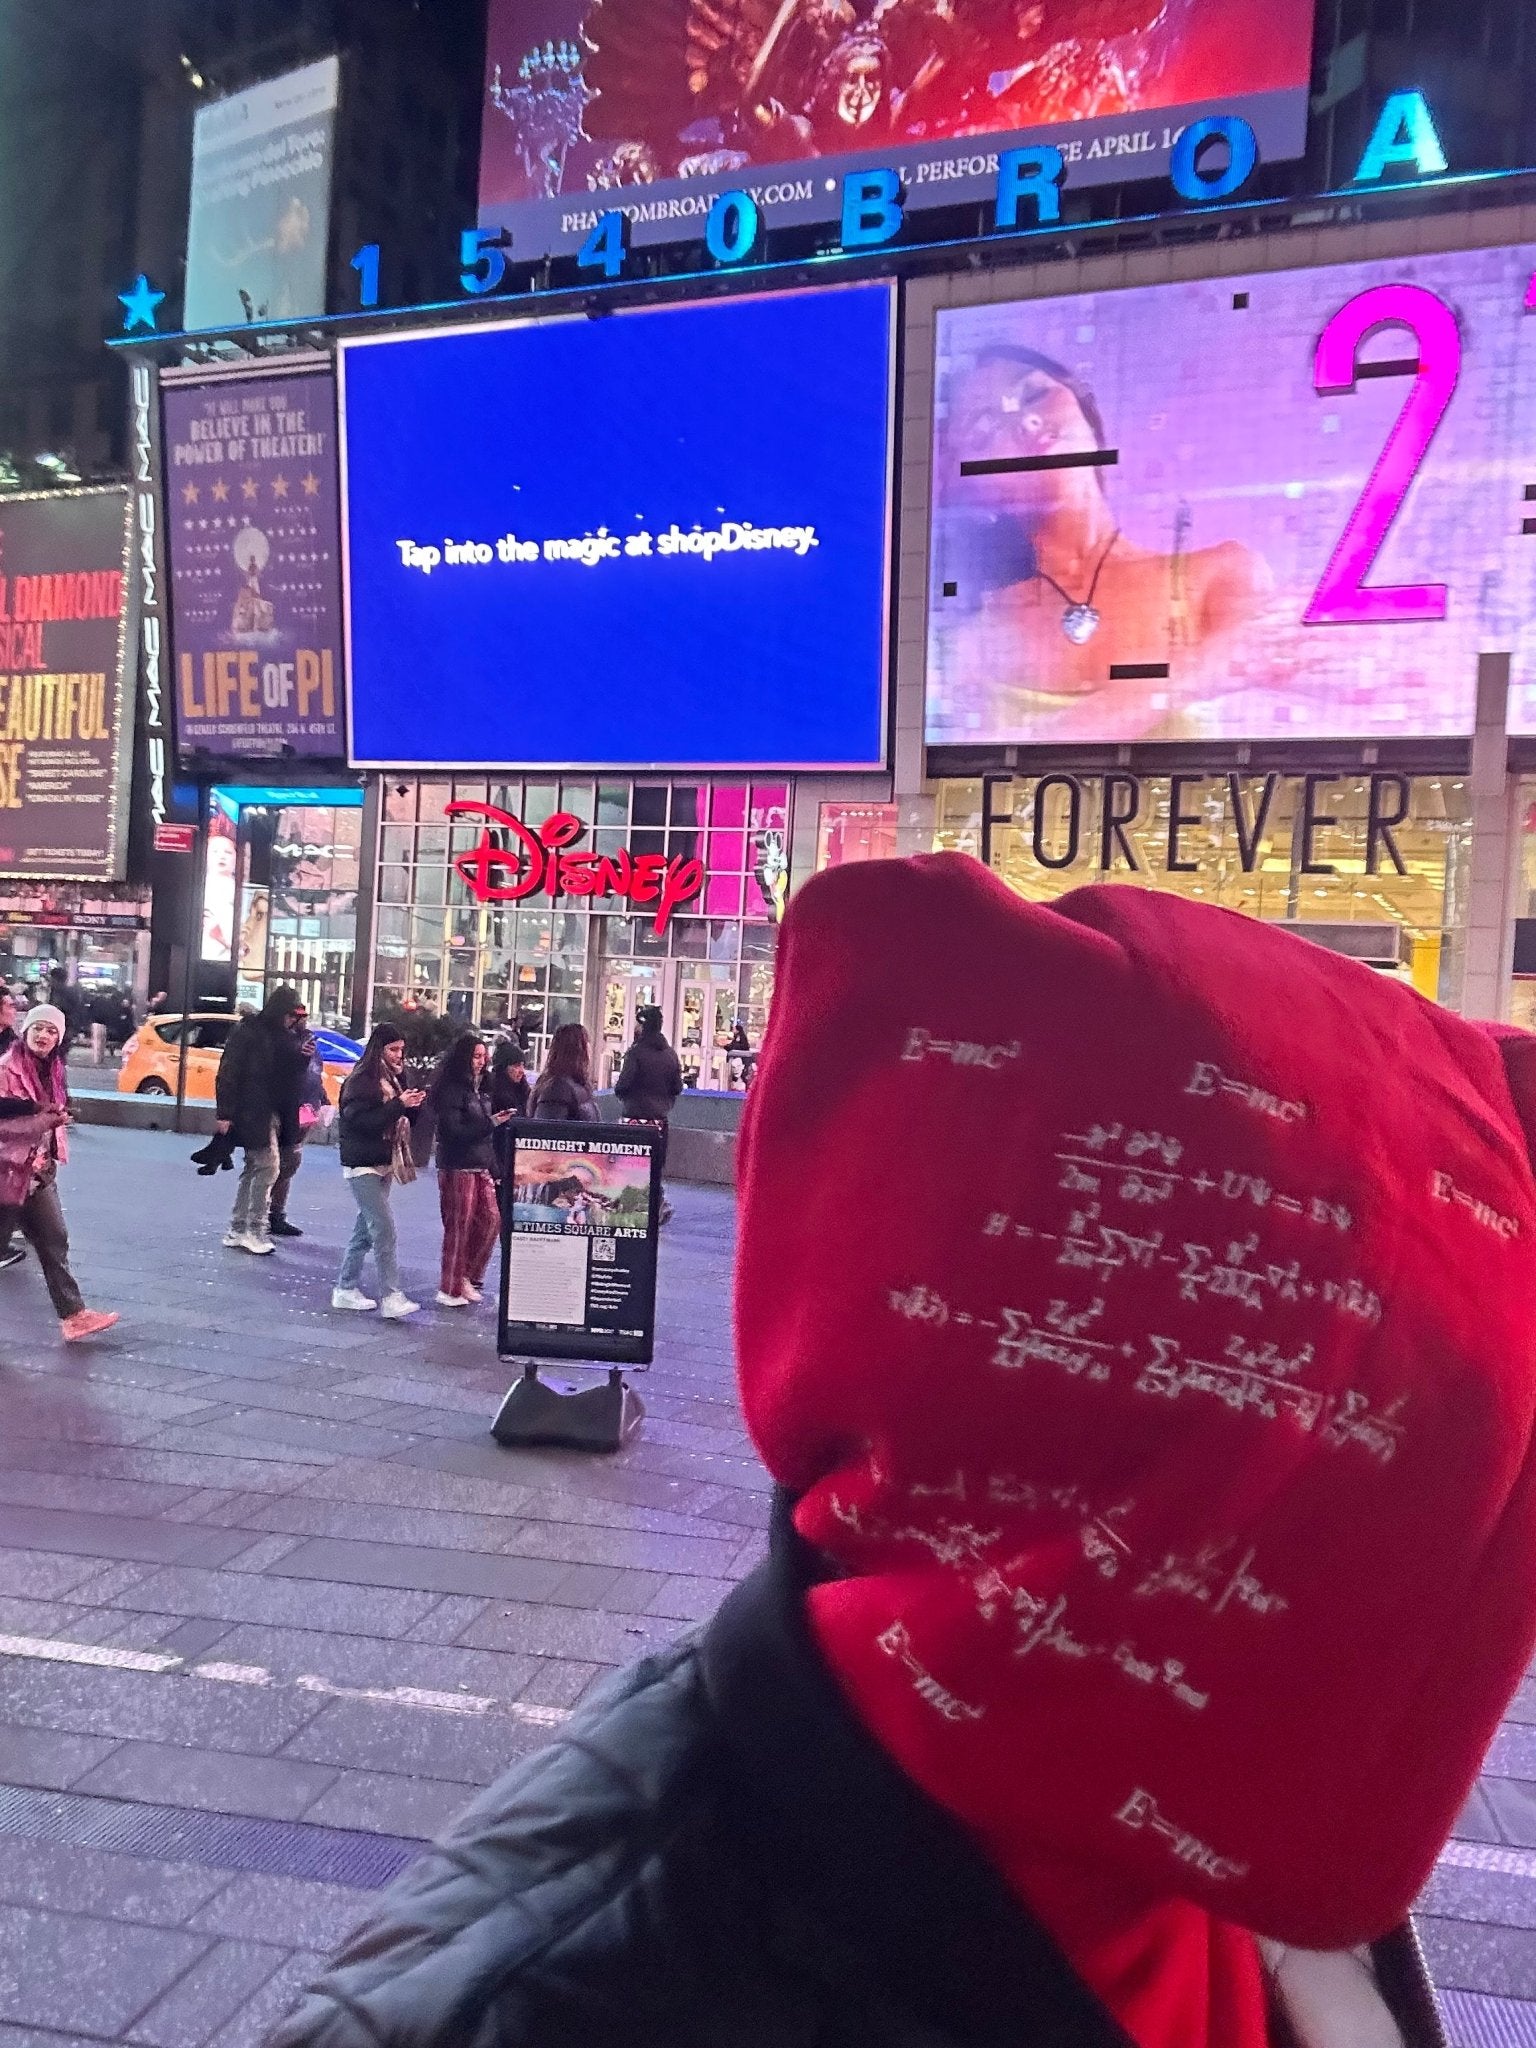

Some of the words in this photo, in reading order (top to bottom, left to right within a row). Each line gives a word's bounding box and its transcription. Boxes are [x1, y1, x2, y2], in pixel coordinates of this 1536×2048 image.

[1086, 129, 1157, 163] APRIL
[190, 414, 250, 442] BELIEVE
[253, 412, 272, 436] IN
[276, 408, 306, 434] THE
[227, 438, 246, 461] OF
[1301, 270, 1536, 626] 2
[395, 538, 441, 575] Tap
[444, 537, 493, 566] into
[497, 533, 540, 563] the
[543, 528, 622, 566] magic
[624, 530, 654, 557] at
[657, 521, 820, 562] shopDisney.
[13, 570, 122, 623] DIAMOND
[180, 650, 262, 718] LIFE
[263, 662, 295, 708] OF
[295, 648, 336, 717] PI
[980, 771, 1413, 876] FOREVER
[73, 914, 107, 925] SONY
[514, 1137, 586, 1154] MIDNIGHT
[588, 1141, 652, 1157] MOMENT
[522, 1221, 562, 1234] TIMES
[563, 1224, 612, 1237] SQUARE
[613, 1226, 648, 1239] ARTS
